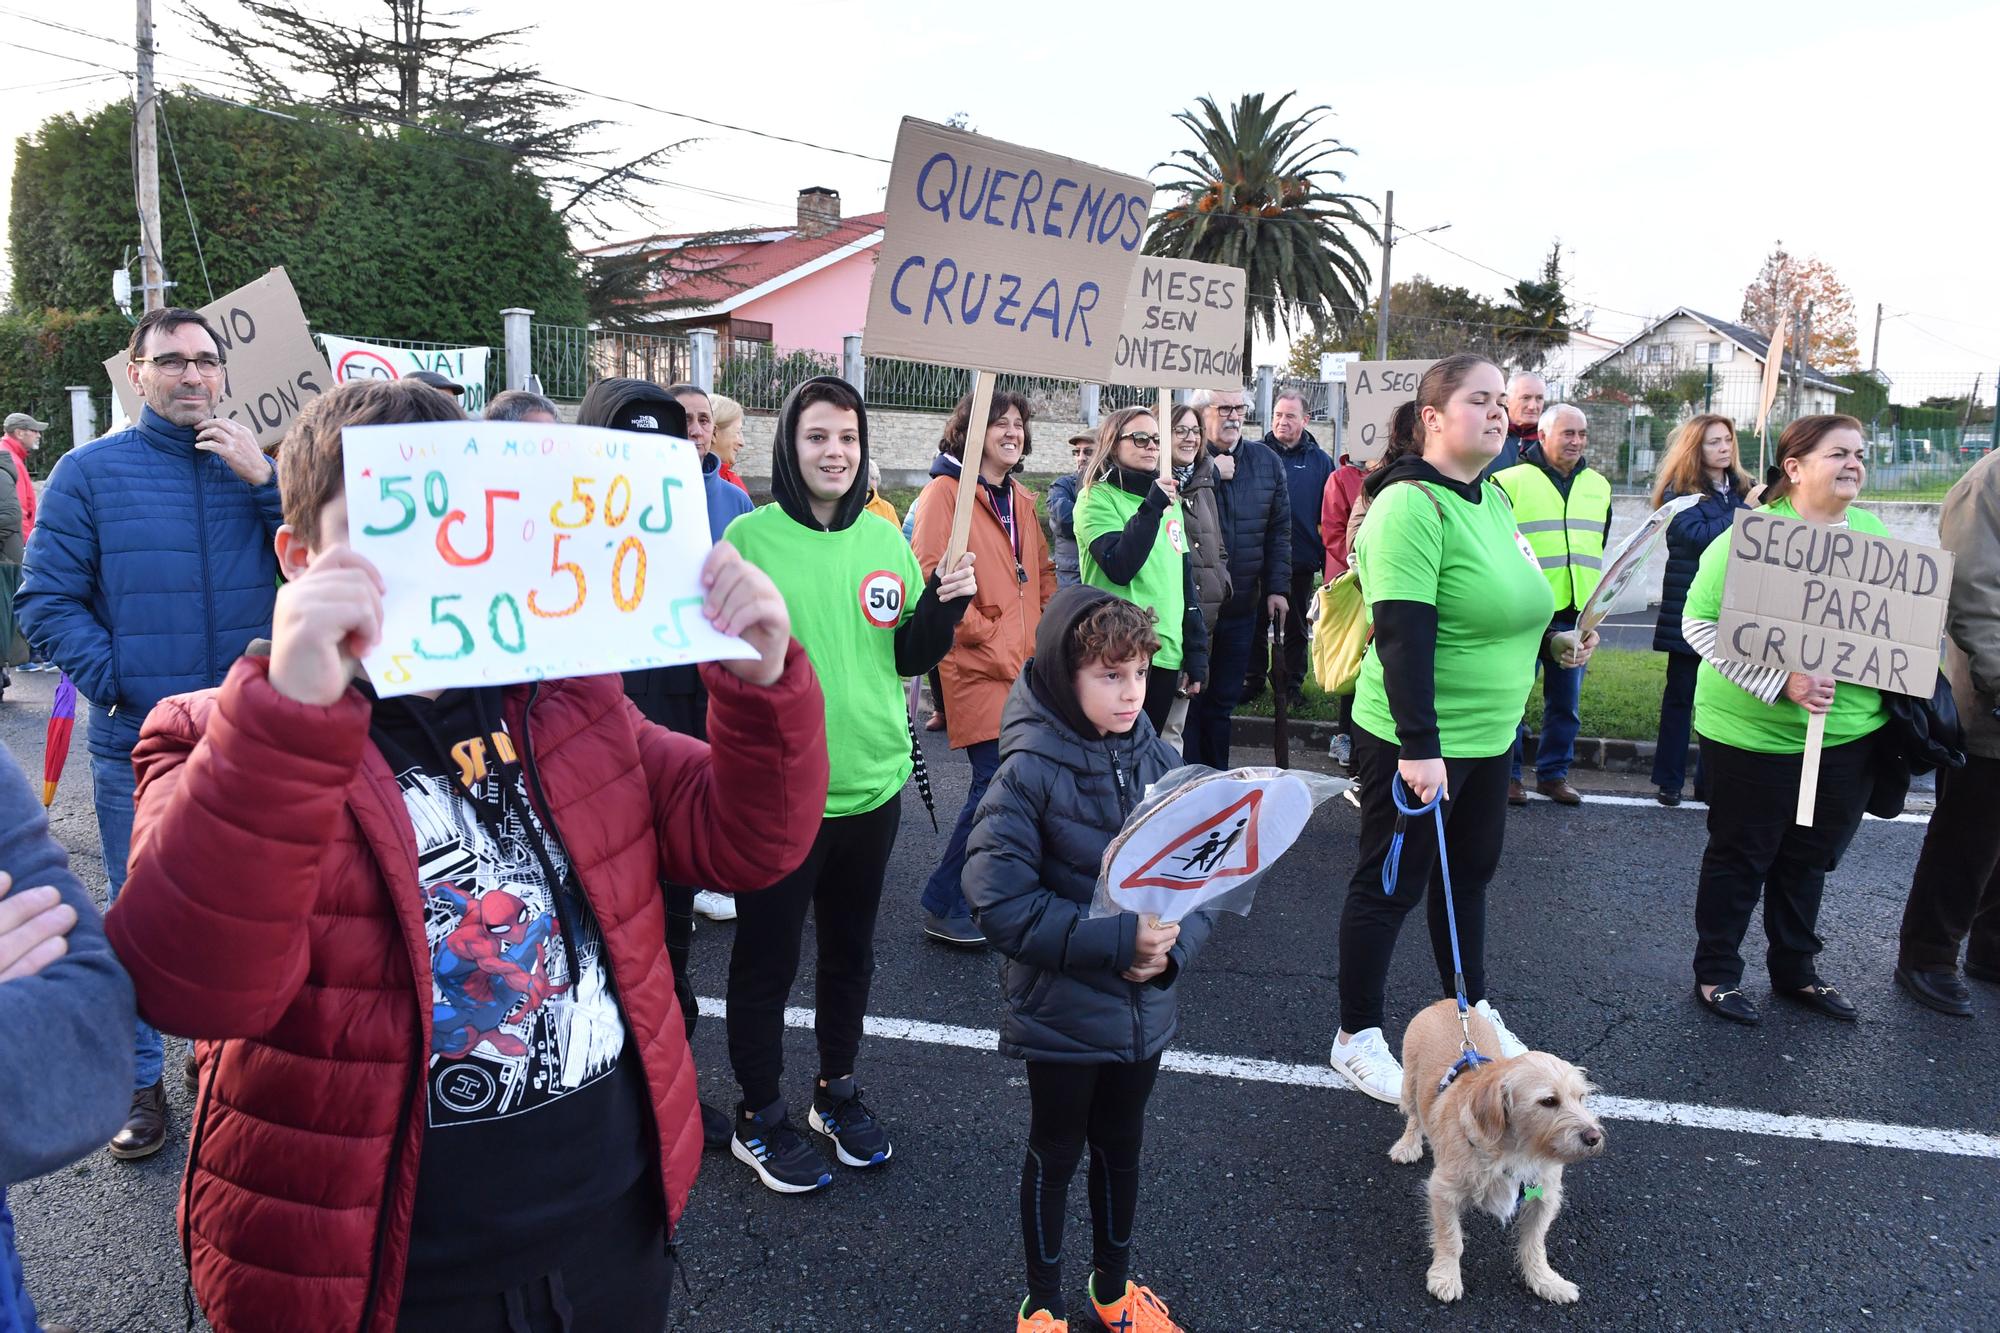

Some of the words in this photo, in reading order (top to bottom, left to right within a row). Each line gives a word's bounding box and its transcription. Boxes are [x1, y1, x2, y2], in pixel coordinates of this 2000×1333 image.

[916, 152, 1147, 251] QUEREMOS
[890, 255, 1100, 347] CRUZAR
[1141, 266, 1236, 310] MESES
[1141, 305, 1197, 332] SEN
[1114, 333, 1243, 377] ONTESTACIÓN
[1354, 369, 1373, 395] A
[463, 437, 478, 454] A
[363, 470, 449, 536] 50
[549, 474, 632, 529] 50
[527, 533, 646, 618] 50
[1736, 516, 1939, 595] SEGURIDAD
[411, 592, 527, 660] 50
[870, 587, 900, 611] 50
[1802, 580, 1891, 639] PARA
[1732, 622, 1909, 694] CRUZAR
